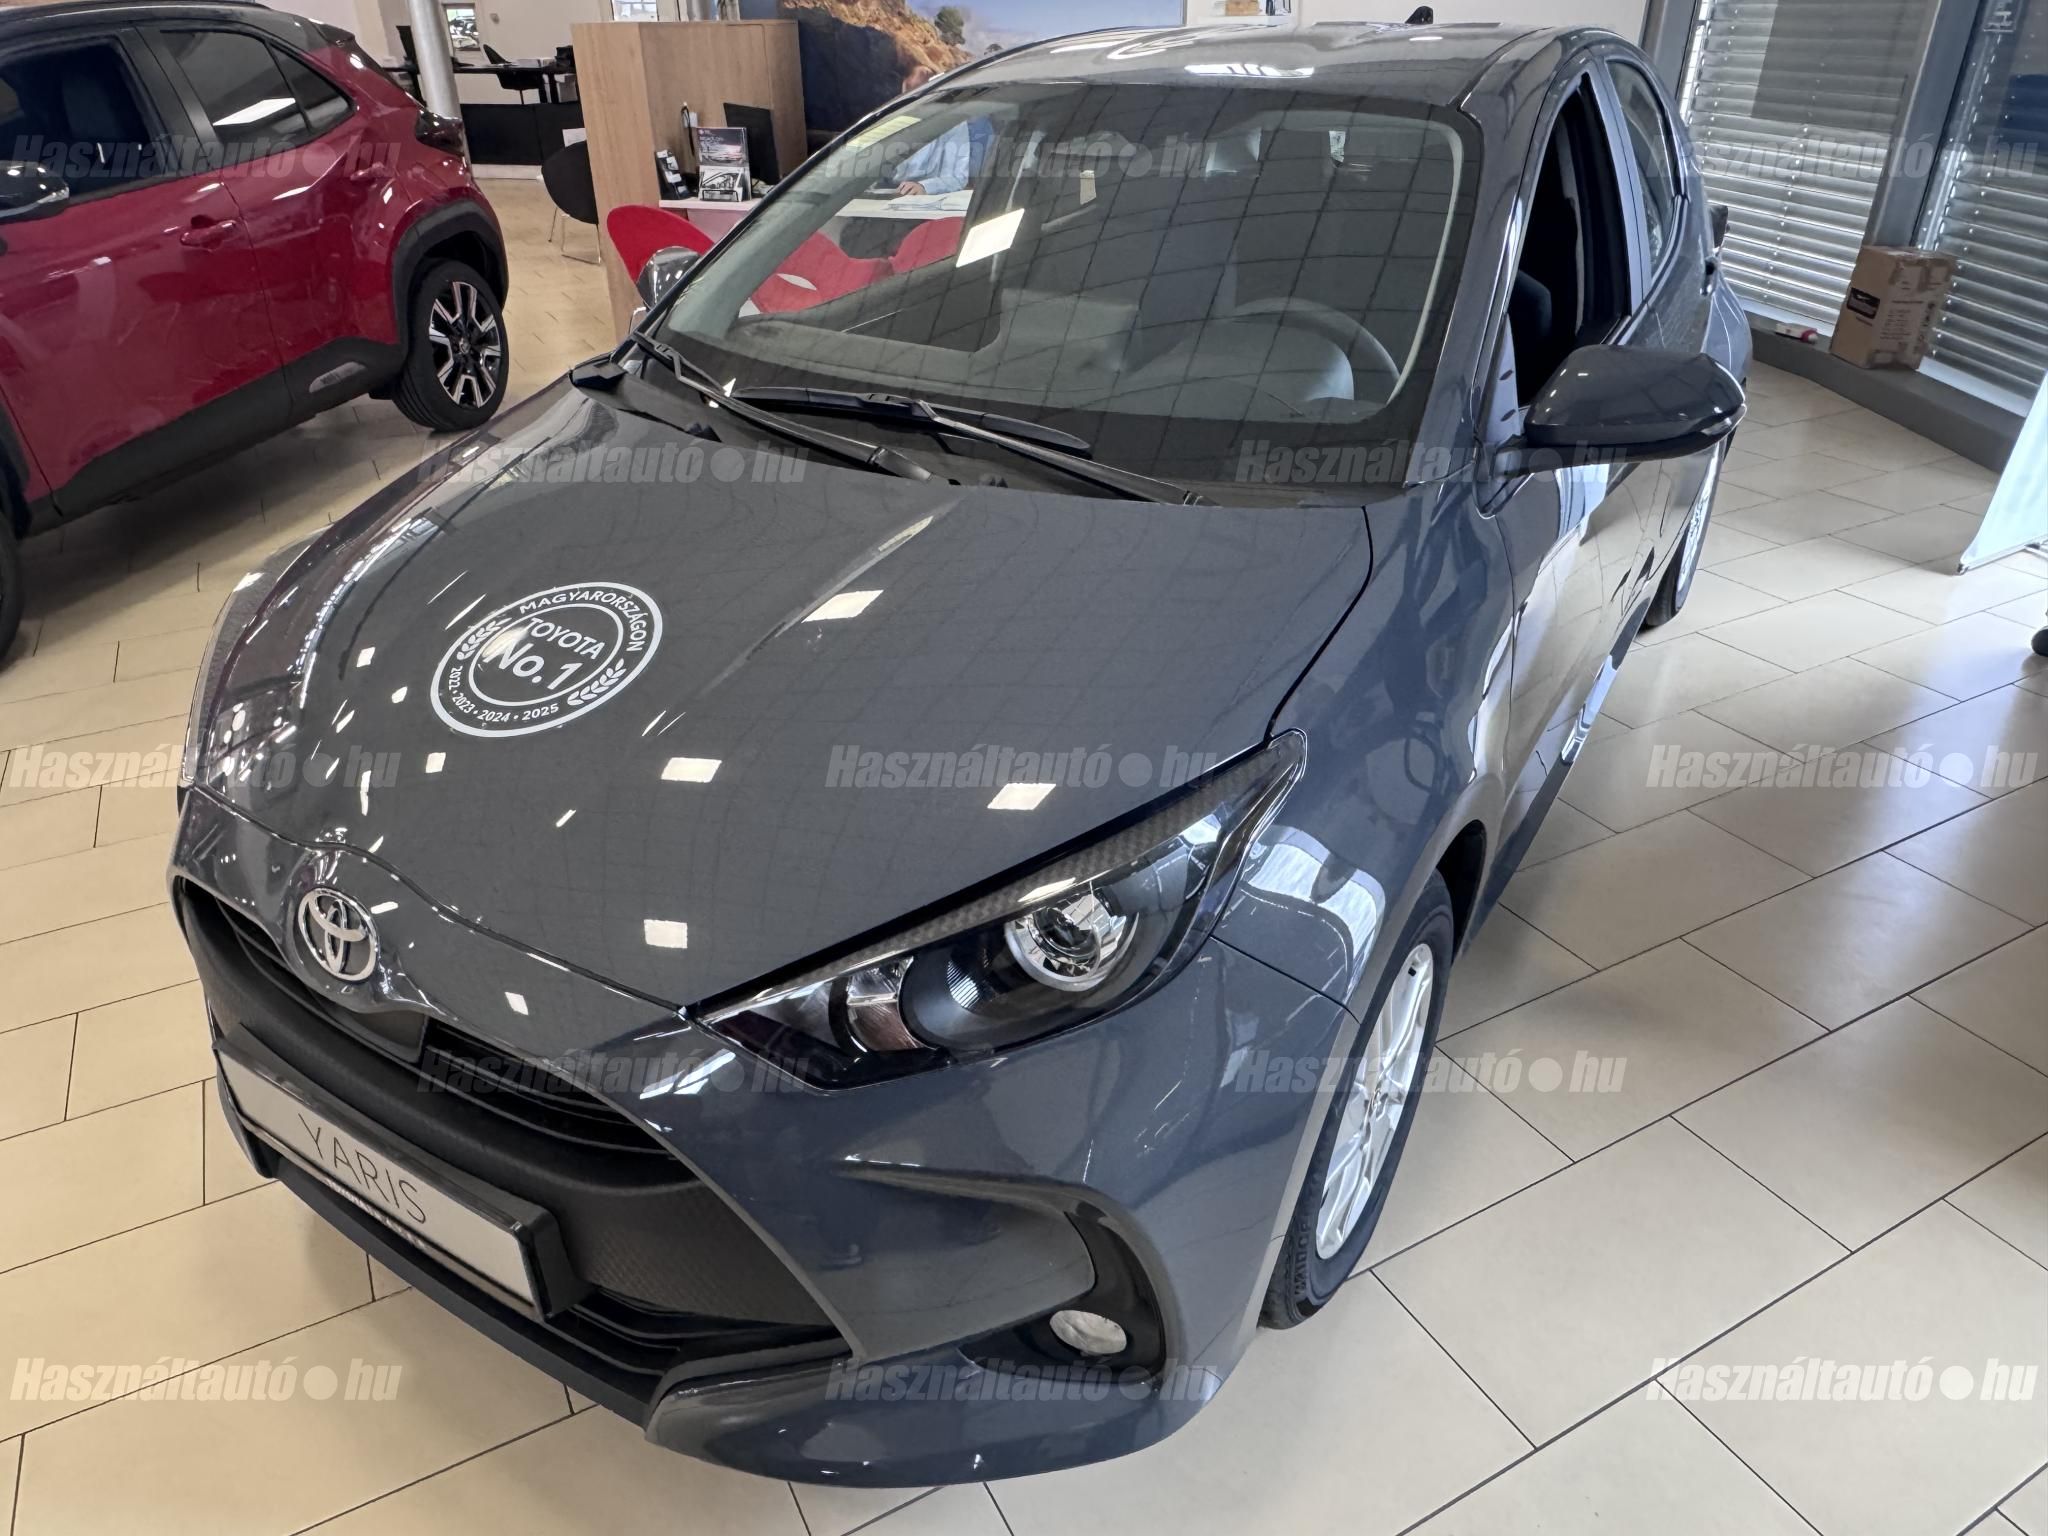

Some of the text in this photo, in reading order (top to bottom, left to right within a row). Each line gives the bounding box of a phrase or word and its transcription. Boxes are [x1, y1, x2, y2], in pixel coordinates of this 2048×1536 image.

[519, 590, 649, 652] MAGYARORSZÁGON
[523, 617, 606, 660] TOYOTA
[452, 692, 476, 714] 2023
[476, 709, 512, 723] 2024
[521, 702, 560, 721] 2025
[298, 1113, 426, 1225] YARIS
